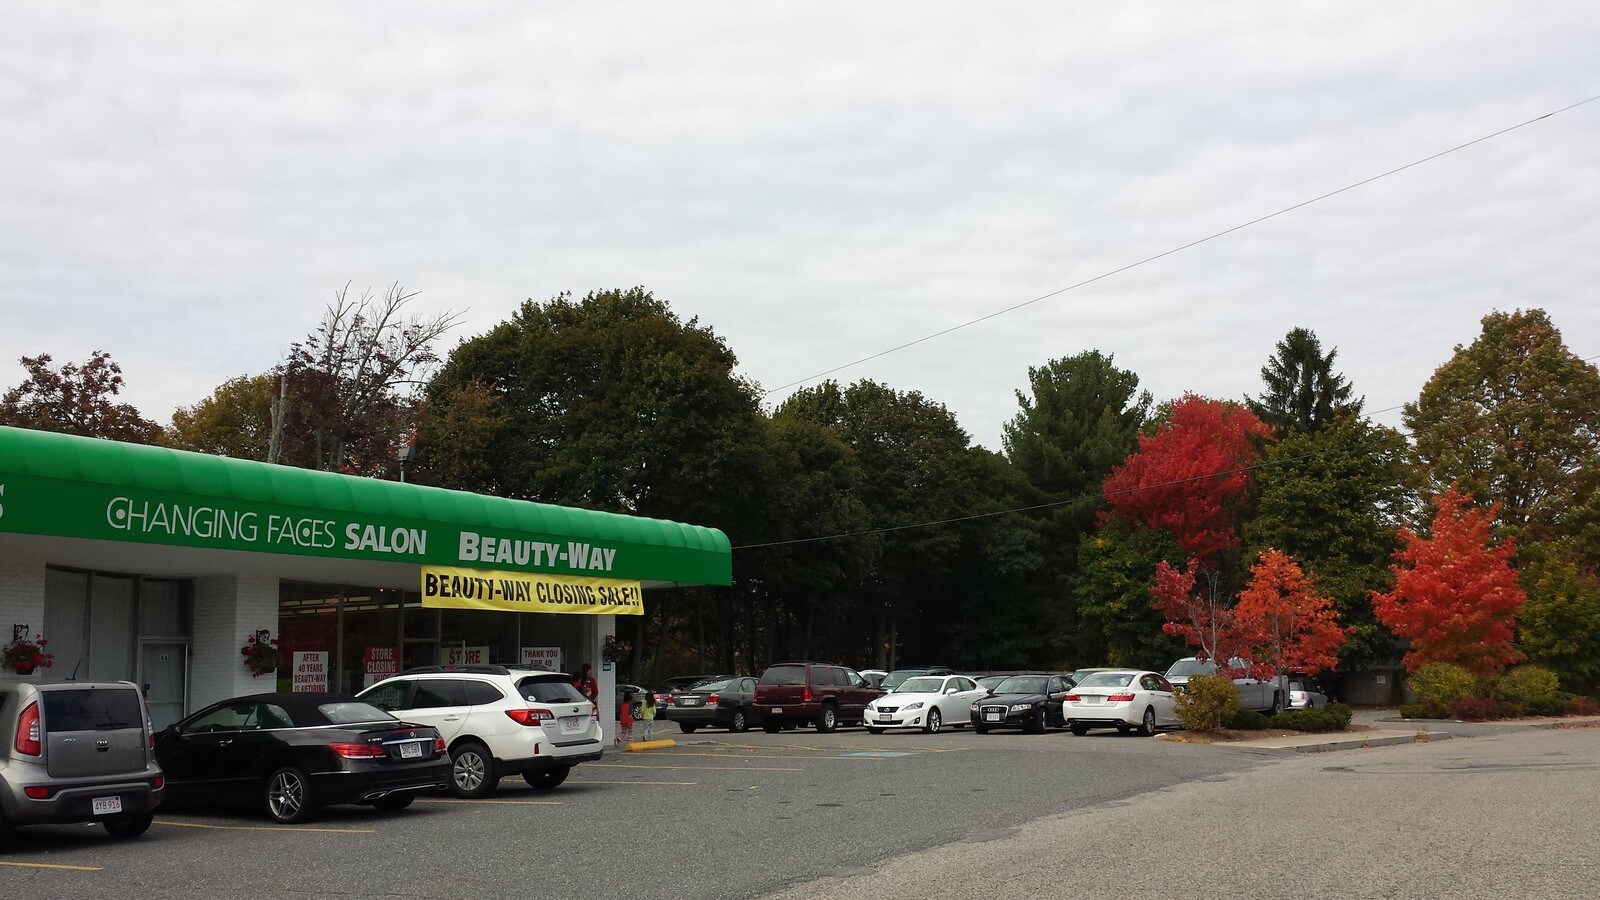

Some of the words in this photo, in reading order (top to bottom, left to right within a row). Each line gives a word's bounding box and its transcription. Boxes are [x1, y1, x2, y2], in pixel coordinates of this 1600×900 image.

[106, 496, 258, 542] CHANGING
[267, 515, 336, 549] FACES
[344, 522, 427, 555] SALON
[425, 573, 532, 602] BEAUTY-WAY
[536, 581, 596, 606] CLOSING
[598, 586, 640, 606] SALE!!
[303, 653, 320, 662] AFTER
[371, 648, 393, 660] STORE
[525, 650, 545, 658] THANK
[546, 650, 558, 658] YOU
[298, 664, 307, 673] 40
[307, 664, 323, 673] YEARS
[367, 661, 396, 673] CLOSING
[294, 674, 326, 684] BEAUTY-WAY
[95, 801, 107, 811] 4YB
[108, 800, 121, 810] 916
